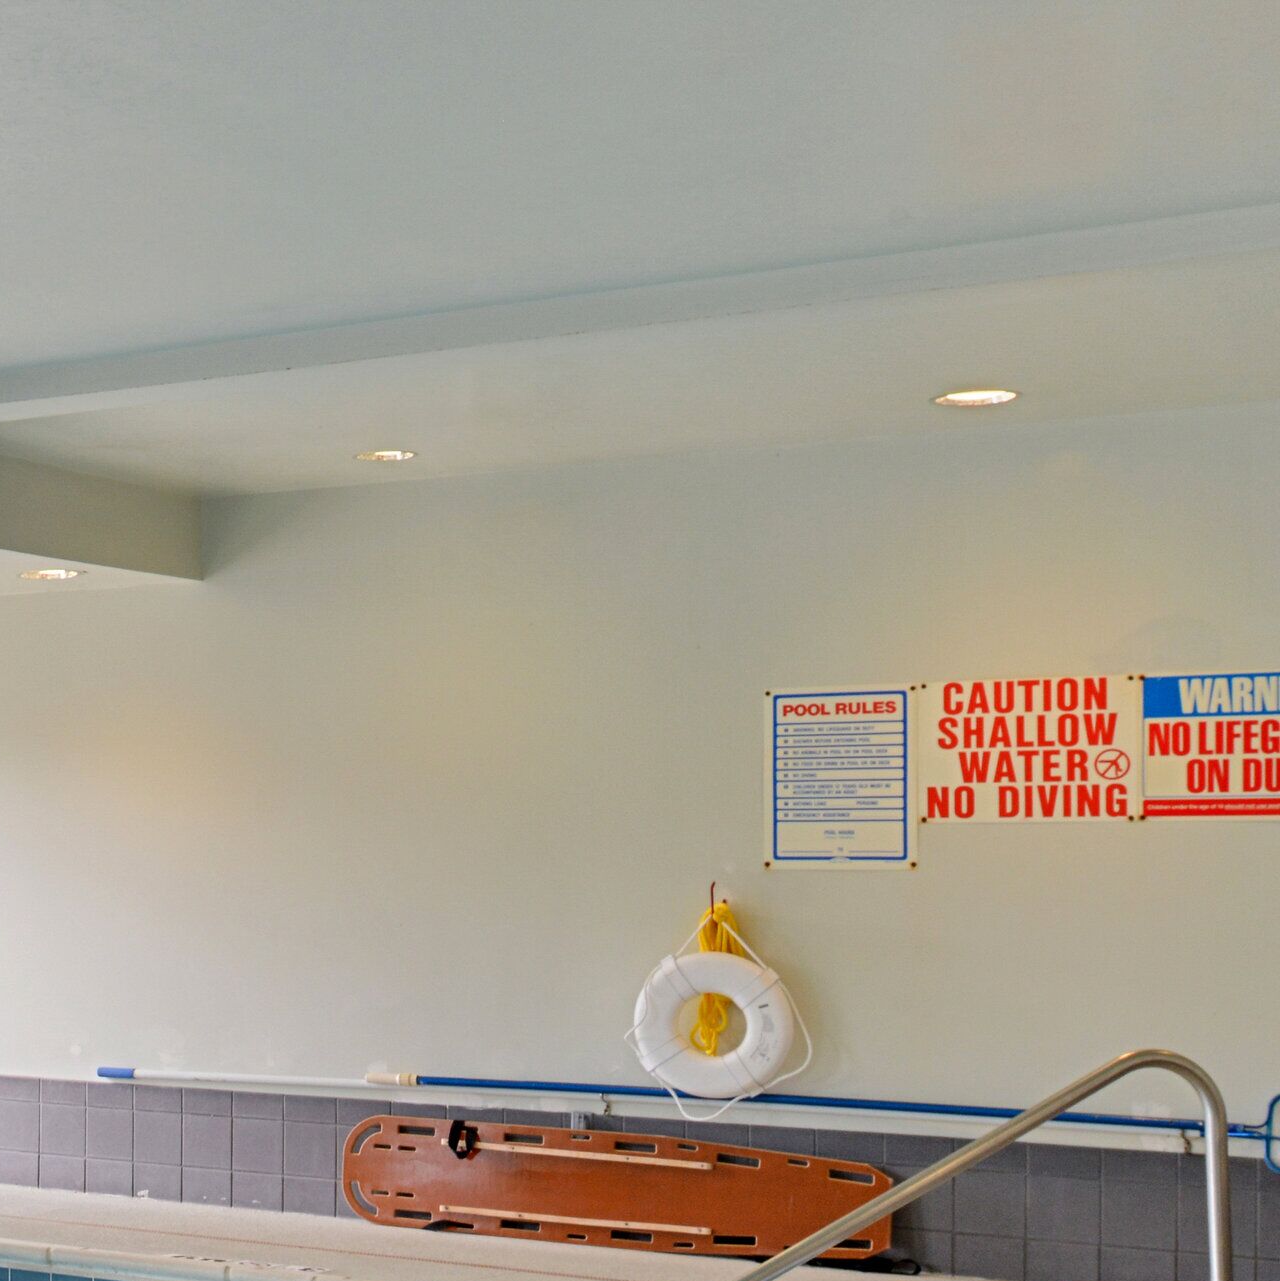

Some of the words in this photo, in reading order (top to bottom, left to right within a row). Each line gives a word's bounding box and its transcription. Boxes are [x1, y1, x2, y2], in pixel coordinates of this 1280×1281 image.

[782, 703, 831, 717] POOL
[835, 700, 897, 715] RULES
[943, 677, 1107, 715] CAUTION
[1178, 675, 1280, 714] WARN
[937, 712, 1118, 750] SHALLOW
[1148, 721, 1191, 756] NO
[958, 749, 1089, 784] WATER
[1187, 758, 1230, 794] ON
[927, 785, 975, 819] NO
[998, 783, 1128, 819] DIVING
